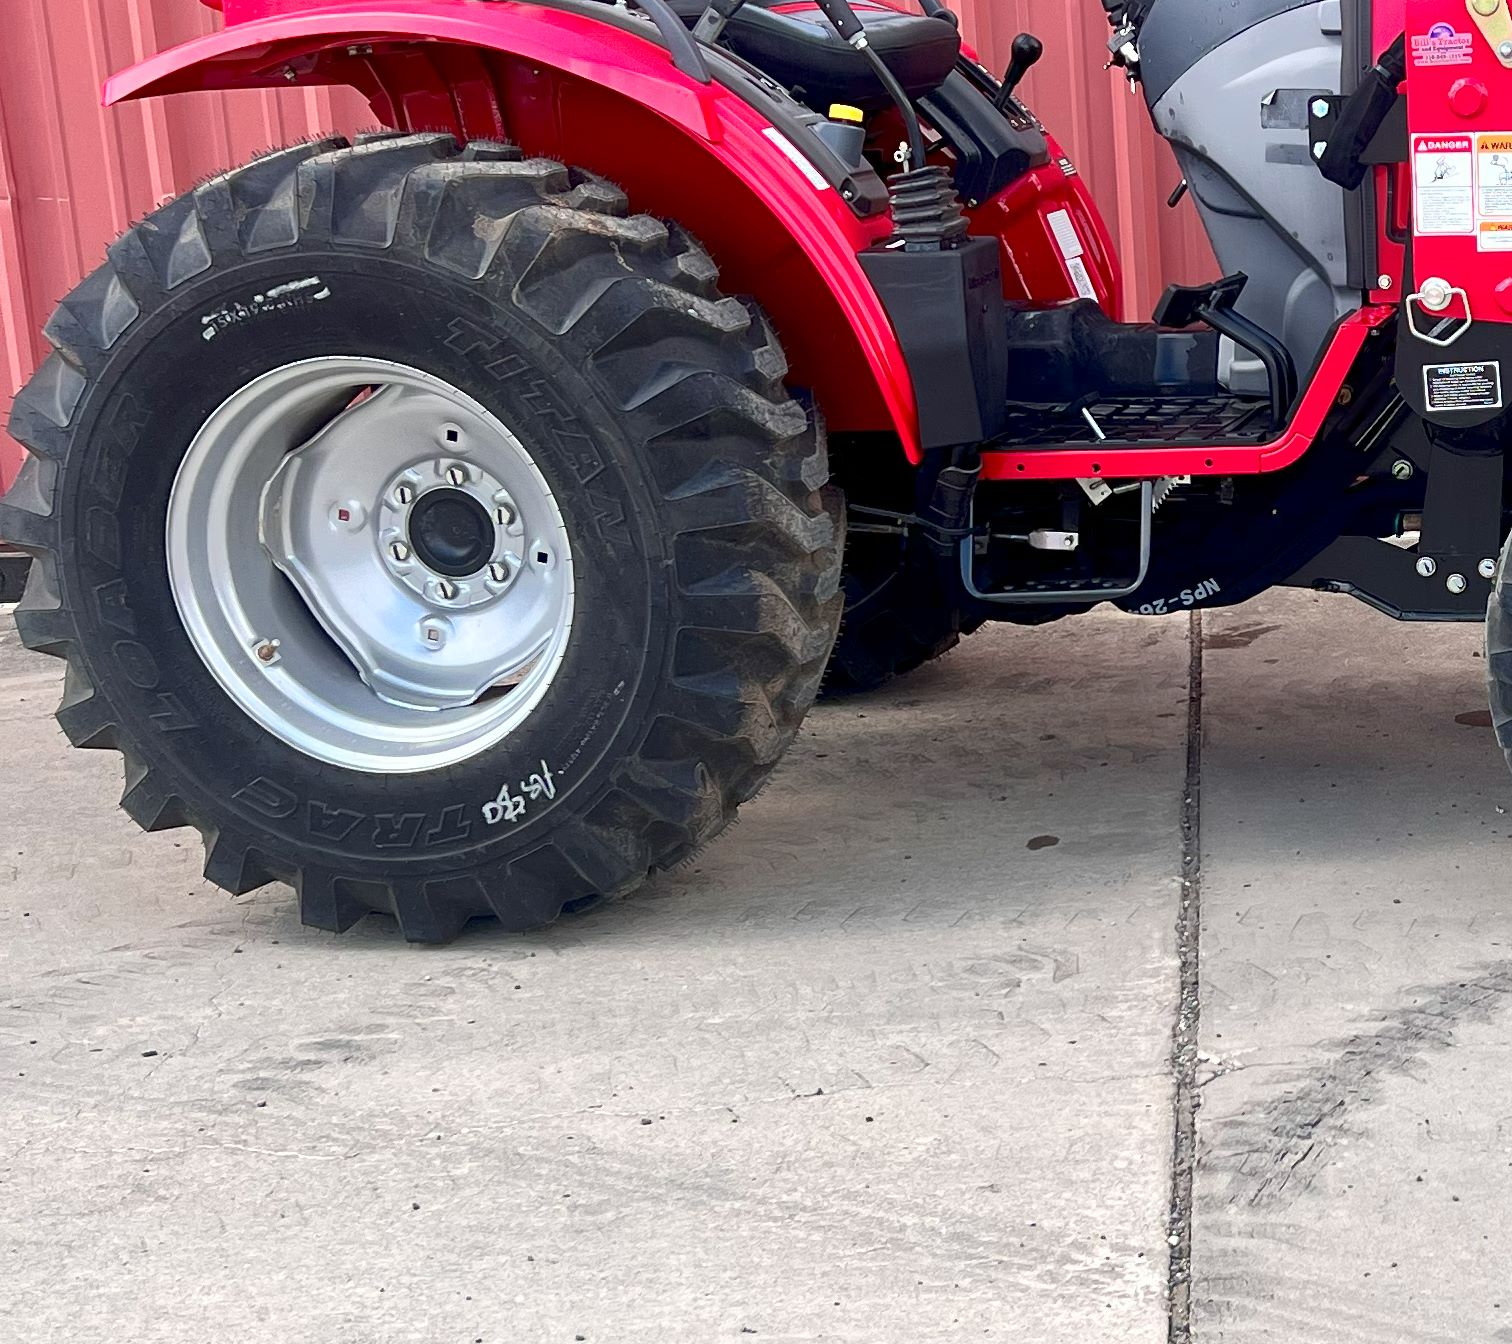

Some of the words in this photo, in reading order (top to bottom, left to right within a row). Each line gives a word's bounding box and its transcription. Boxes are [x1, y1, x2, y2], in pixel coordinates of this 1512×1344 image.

[1427, 141, 1469, 150] DANGER
[443, 316, 637, 561] TITAN
[84, 392, 199, 733] LOADER
[232, 776, 472, 848] TRAC
